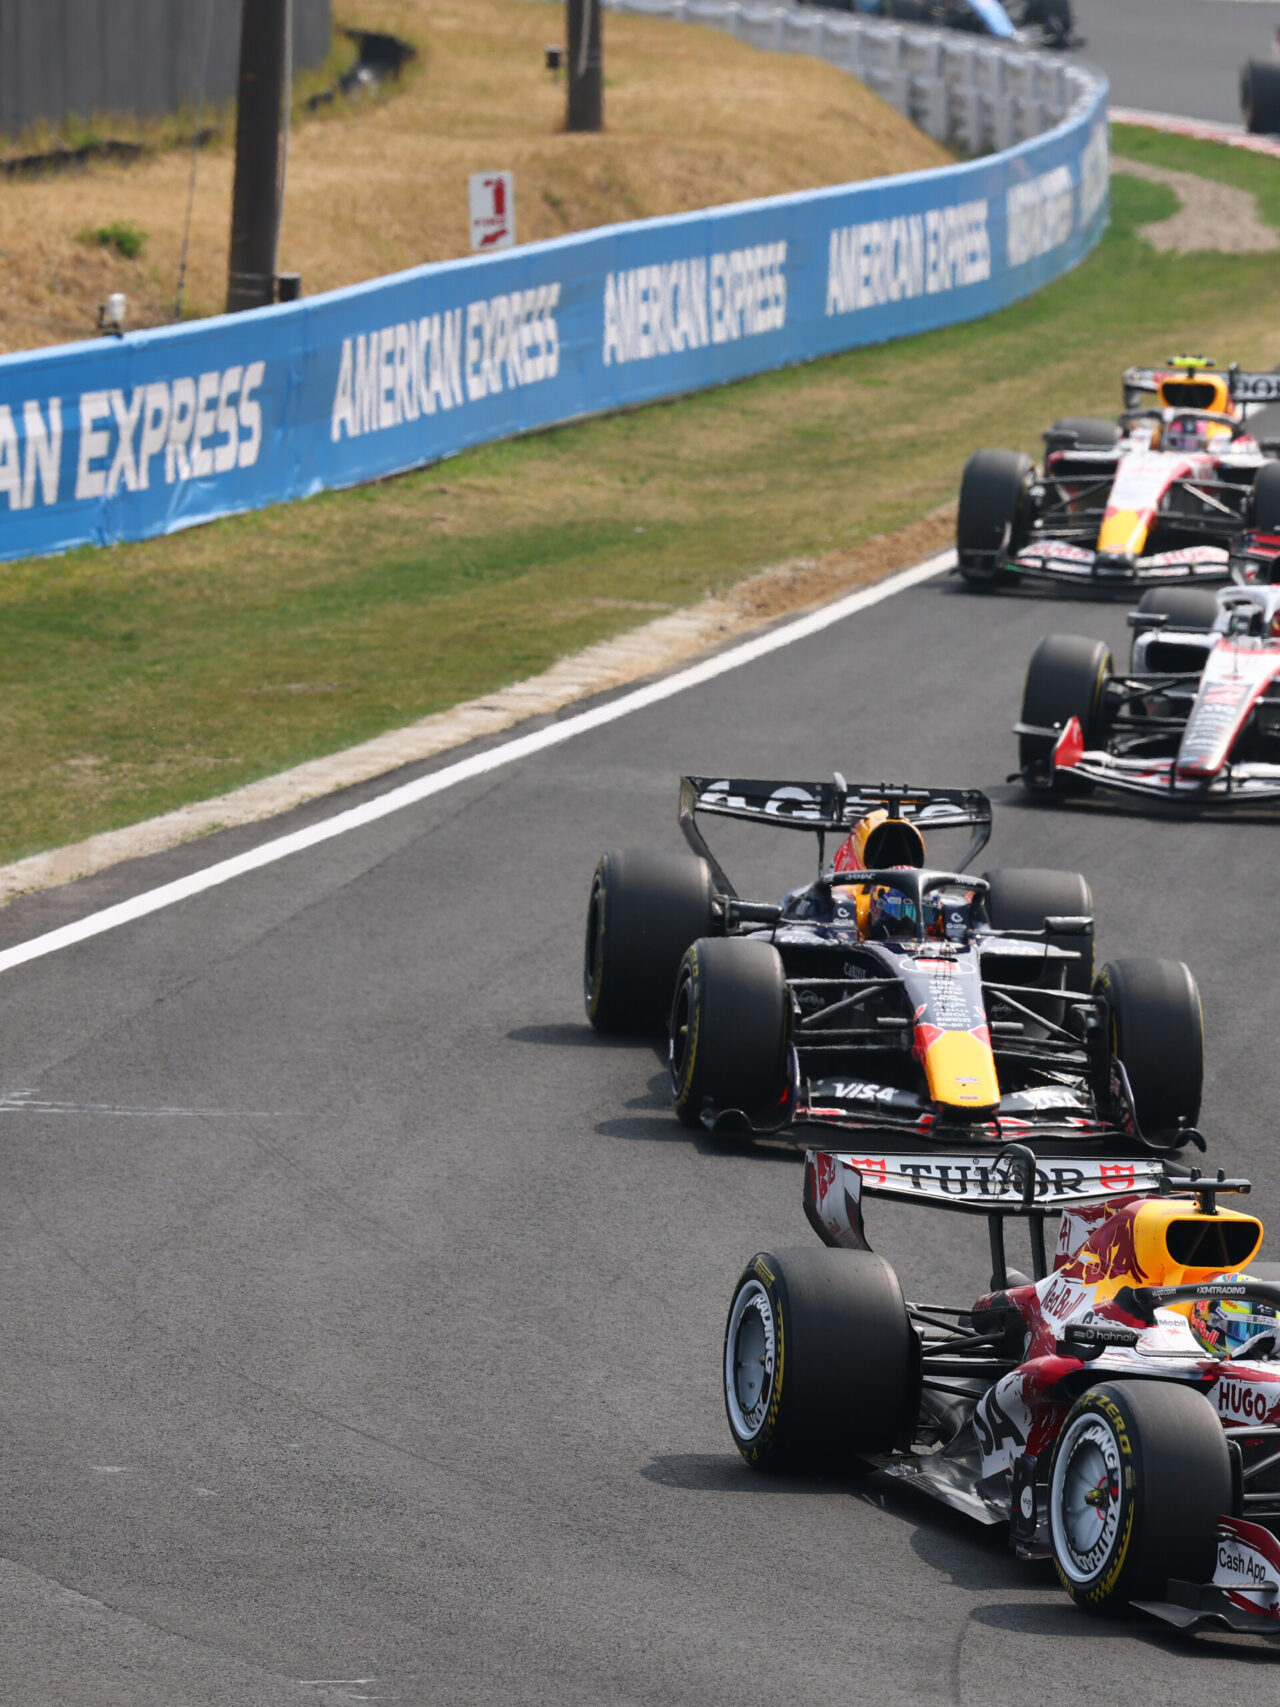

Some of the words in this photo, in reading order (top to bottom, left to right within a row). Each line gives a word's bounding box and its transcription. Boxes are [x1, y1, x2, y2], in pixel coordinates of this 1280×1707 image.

[826, 214, 924, 316] AMERICAN
[925, 199, 991, 295] EXPRESS
[603, 256, 709, 366] AMERICAN
[710, 240, 788, 345] EXPRESS
[331, 308, 464, 442] AMERICAN
[465, 282, 561, 402] EXPRESS
[75, 361, 266, 500] EXPRESS
[832, 1082, 899, 1101] VISA
[899, 1163, 1089, 1198] TUDOR
[1040, 1279, 1067, 1314] Red
[1052, 1288, 1088, 1321] Bull
[1199, 1286, 1246, 1295] XMTRADING
[1096, 1330, 1136, 1342] hahnair
[1160, 1319, 1187, 1327] Mobil
[1218, 1381, 1267, 1421] HUGO
[1096, 1394, 1132, 1455] ZERO
[1218, 1547, 1245, 1574] Cash
[1246, 1556, 1266, 1582] App
